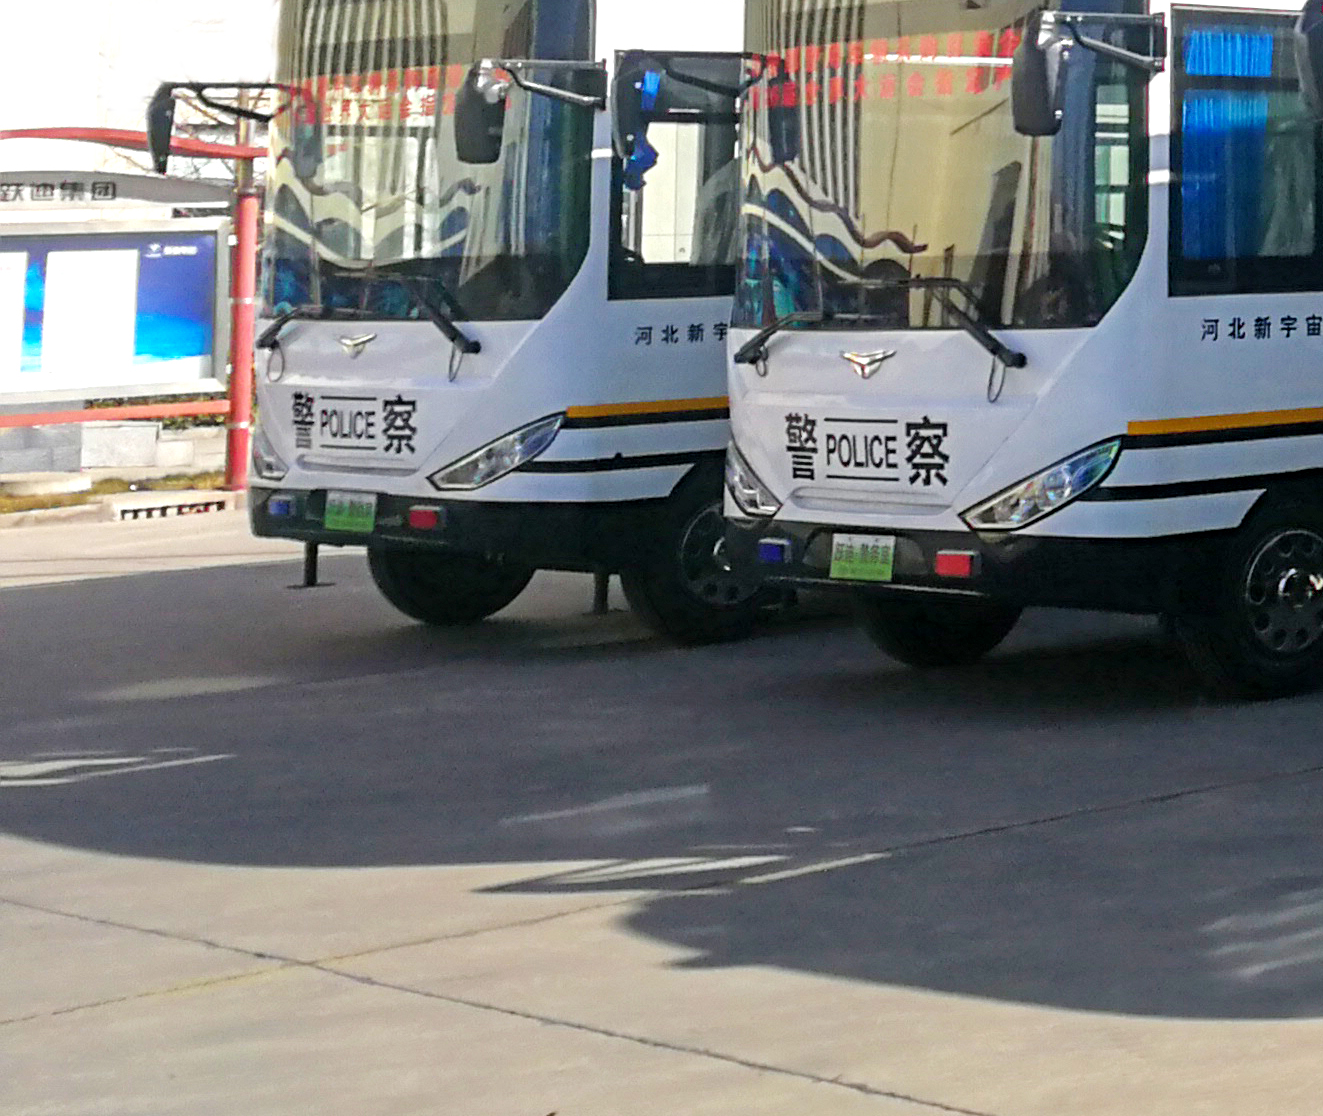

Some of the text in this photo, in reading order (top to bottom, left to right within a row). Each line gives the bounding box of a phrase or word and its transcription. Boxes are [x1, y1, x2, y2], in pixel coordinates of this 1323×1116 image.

[292, 392, 418, 455] 警 POLICE 察
[785, 413, 949, 486] 警 POLICE 察
